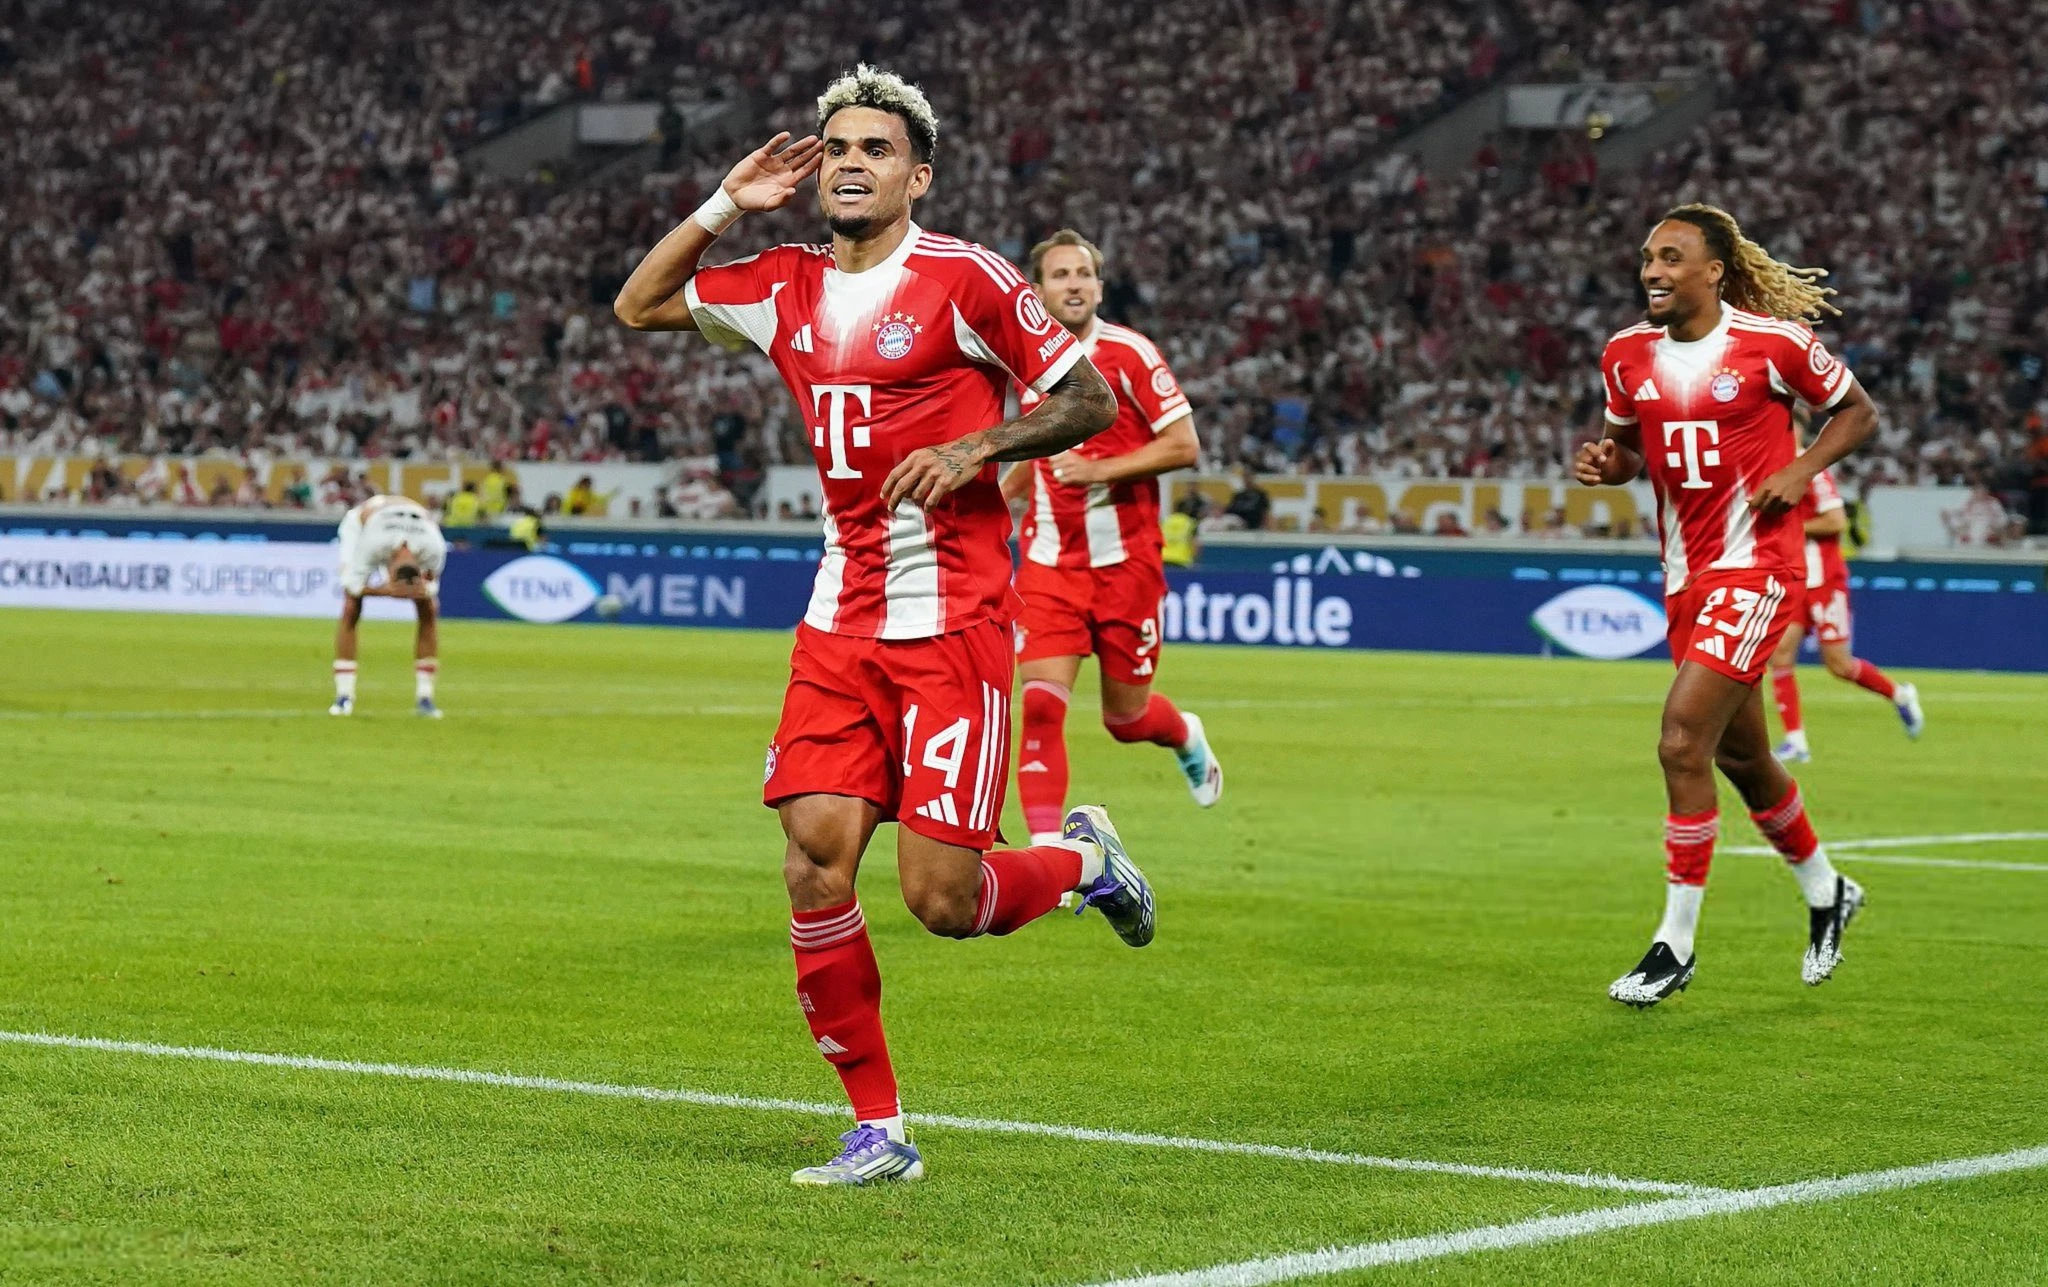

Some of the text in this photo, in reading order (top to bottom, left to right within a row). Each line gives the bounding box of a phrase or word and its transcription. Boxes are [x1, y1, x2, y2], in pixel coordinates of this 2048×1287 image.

[1038, 328, 1070, 362] Allianz
[811, 385, 871, 479] T
[1663, 420, 1720, 489] T
[180, 561, 328, 599] SUPERCUP
[507, 570, 747, 619] TENA MEN
[1136, 616, 1159, 657] 9
[1563, 608, 1643, 634] TENA
[1696, 587, 1761, 637] 23
[901, 703, 971, 788] 14
